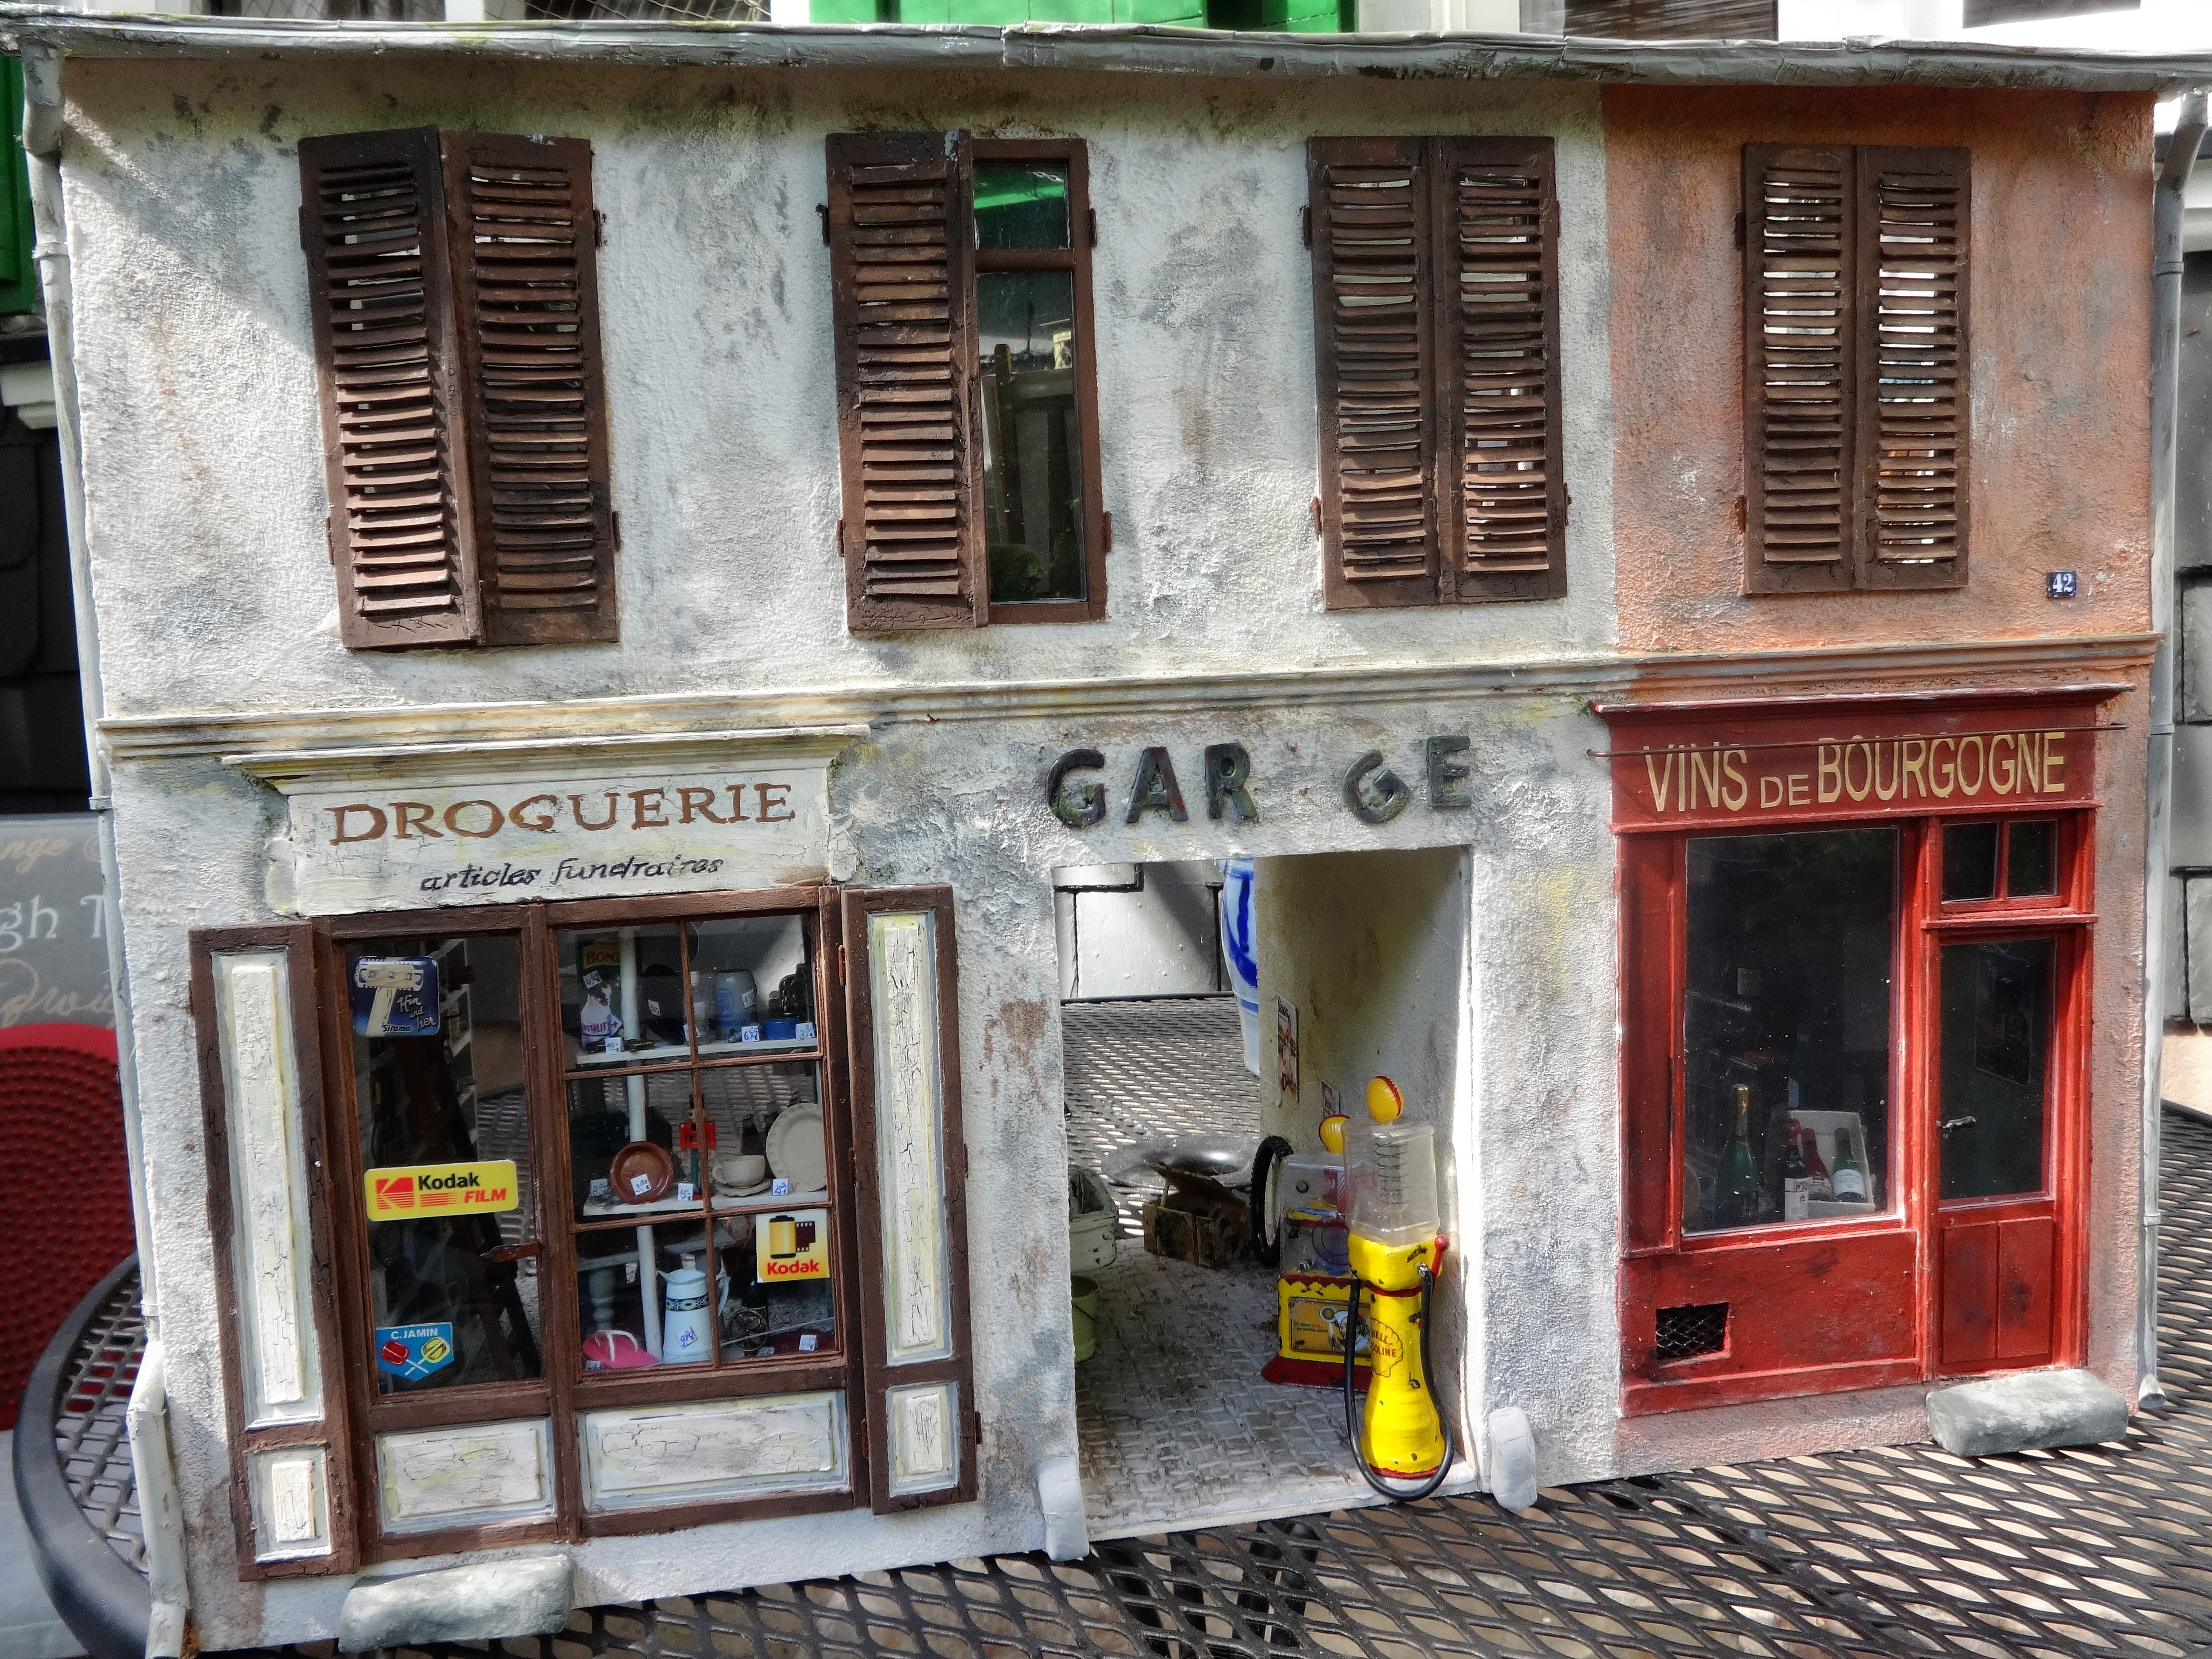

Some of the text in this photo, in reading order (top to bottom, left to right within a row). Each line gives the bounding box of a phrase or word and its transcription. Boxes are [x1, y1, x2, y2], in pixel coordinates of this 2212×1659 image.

[2052, 573, 2073, 593] 42
[1643, 732, 2067, 812] VINS DE BOURGOGNE
[323, 782, 796, 846] DROGUERIE
[420, 862, 542, 891] articles
[409, 1006, 424, 1019] und
[417, 1172, 480, 1190] Kodak
[464, 1188, 507, 1203] FILM
[766, 1259, 820, 1275] Kodak
[1371, 1328, 1393, 1346] HELL
